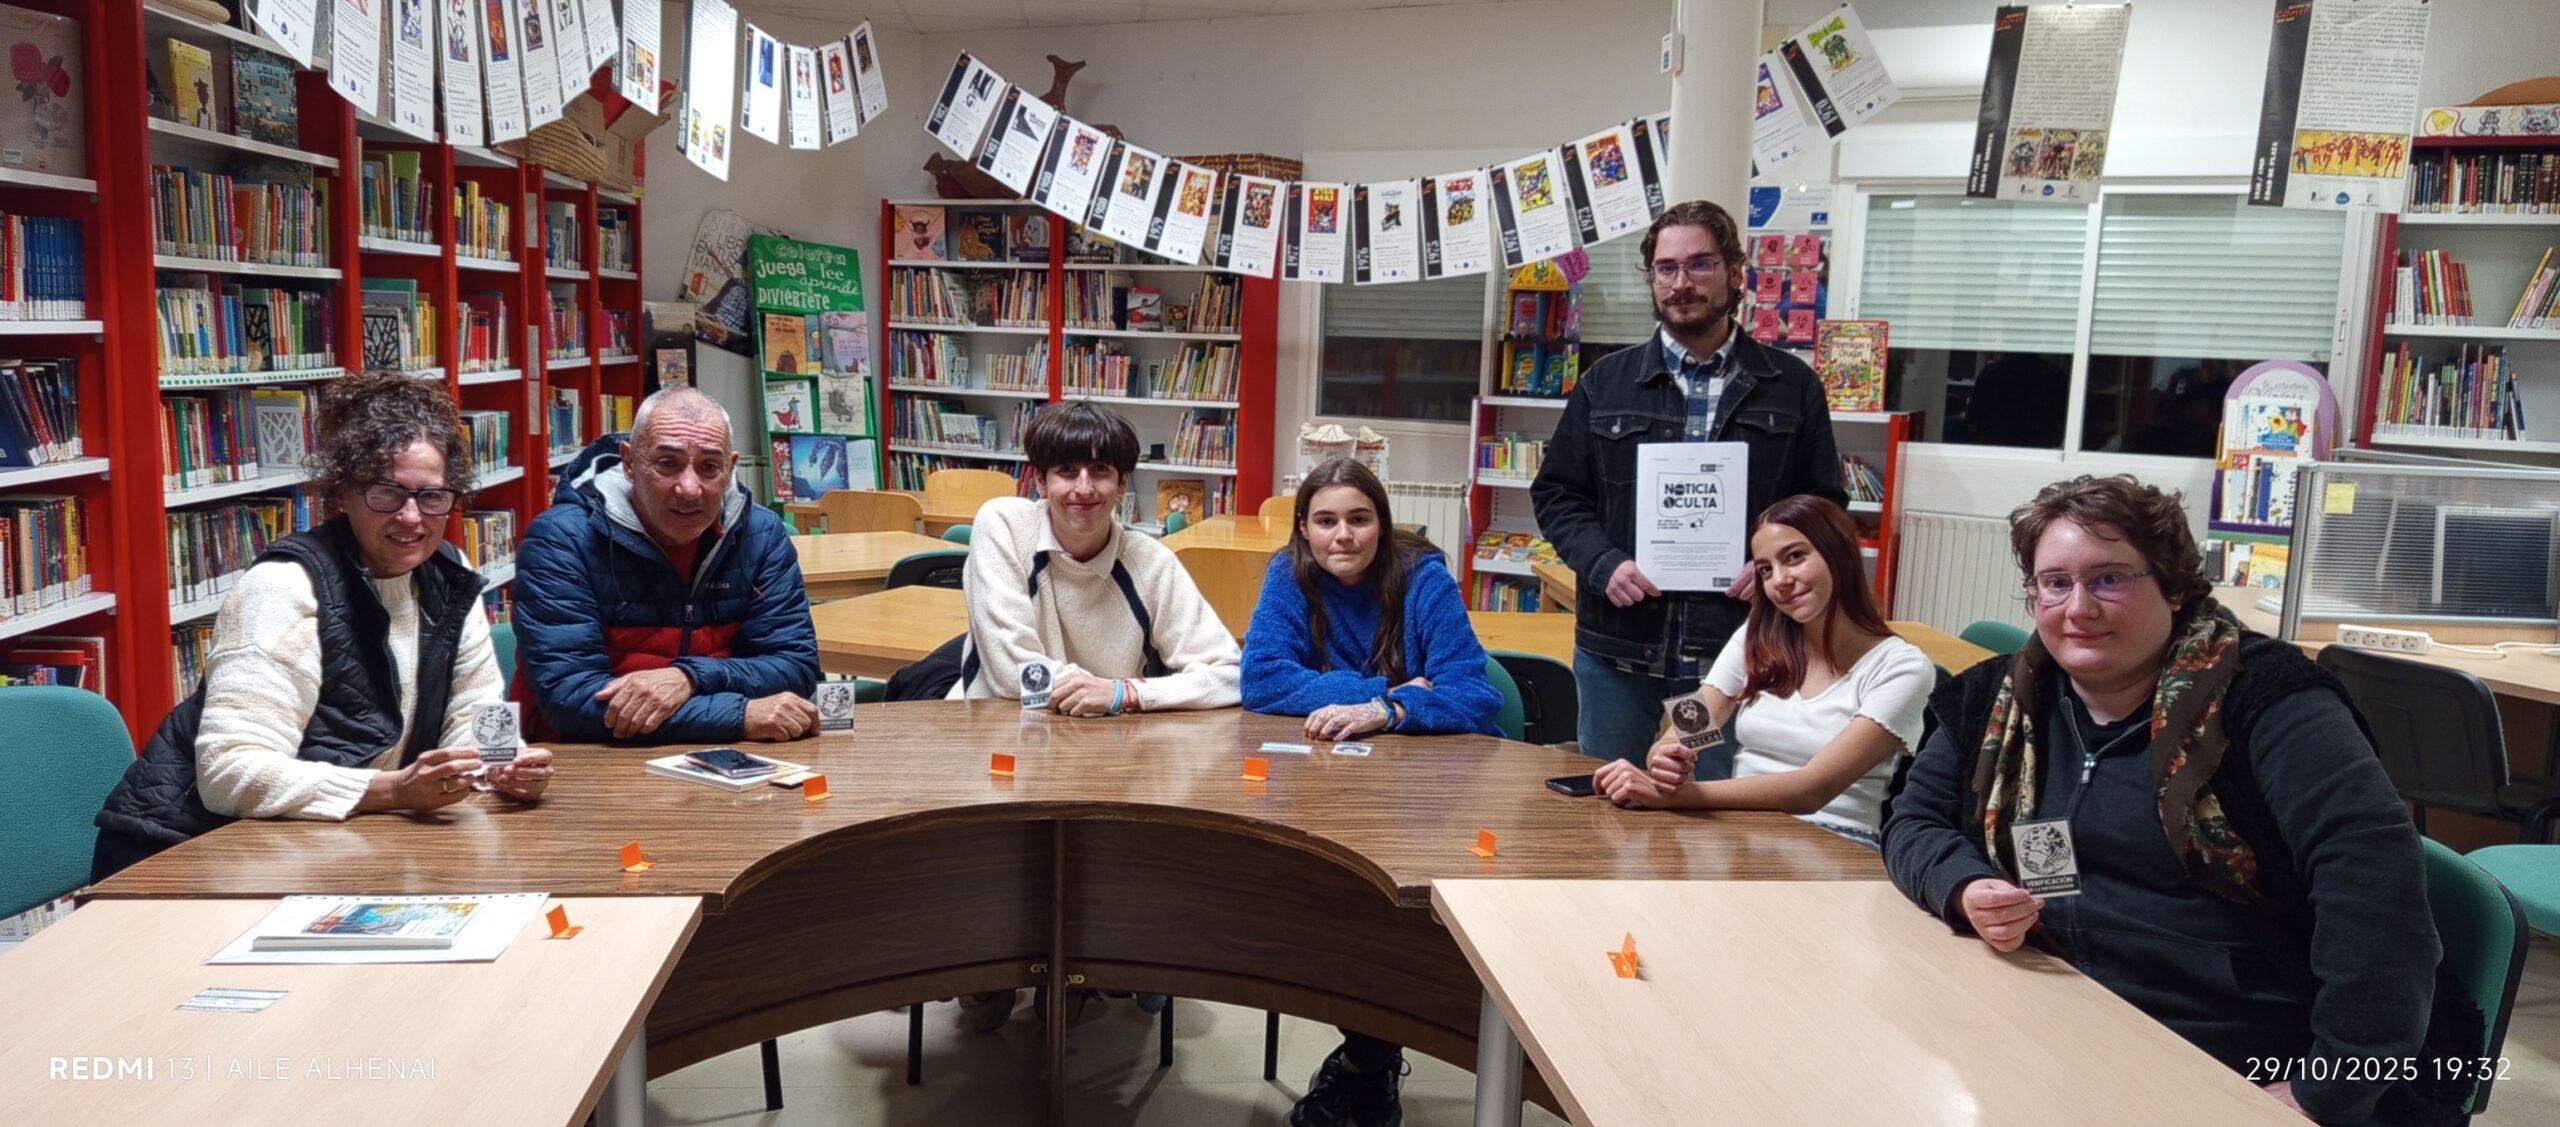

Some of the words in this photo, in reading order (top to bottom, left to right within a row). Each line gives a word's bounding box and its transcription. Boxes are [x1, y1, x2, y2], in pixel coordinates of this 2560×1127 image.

[1815, 98, 1838, 125] 1970
[1646, 183, 1663, 208] 1972
[1148, 217, 1164, 240] 1979
[1577, 206, 1595, 231] 1973
[1218, 233, 1232, 257] 1978
[1427, 240, 1441, 264] 1975
[1503, 229, 1519, 254] 1974
[775, 243, 847, 266] colorea
[1287, 244, 1300, 267] 1977
[1357, 247, 1369, 271] 1976
[756, 259, 806, 278] juega
[820, 263, 845, 281] lee
[800, 276, 860, 296] aprende
[1832, 340, 1865, 350] Hormigas
[1664, 482, 1718, 496] NOTICIA
[1663, 496, 1718, 509] OCULTA
[2025, 877, 2073, 887] VERIFICACIÓN
